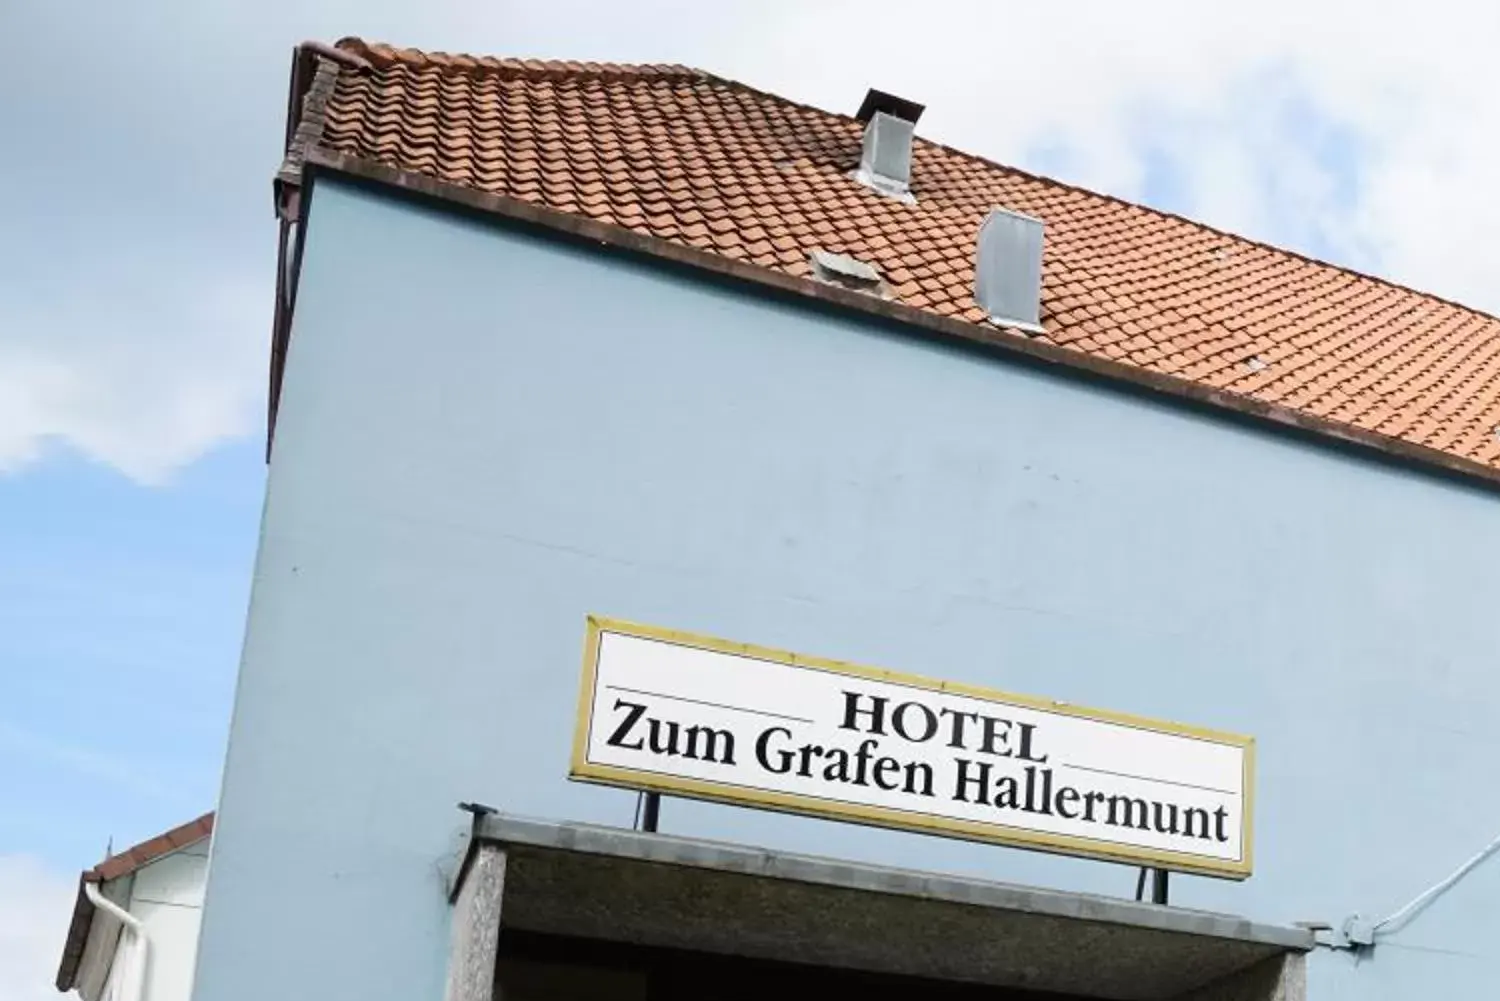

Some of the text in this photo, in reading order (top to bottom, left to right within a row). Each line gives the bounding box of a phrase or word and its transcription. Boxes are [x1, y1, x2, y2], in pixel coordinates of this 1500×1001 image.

[606, 698, 1229, 843] Zum Grafen Hallermunt
[838, 690, 1048, 764] HOTEL
